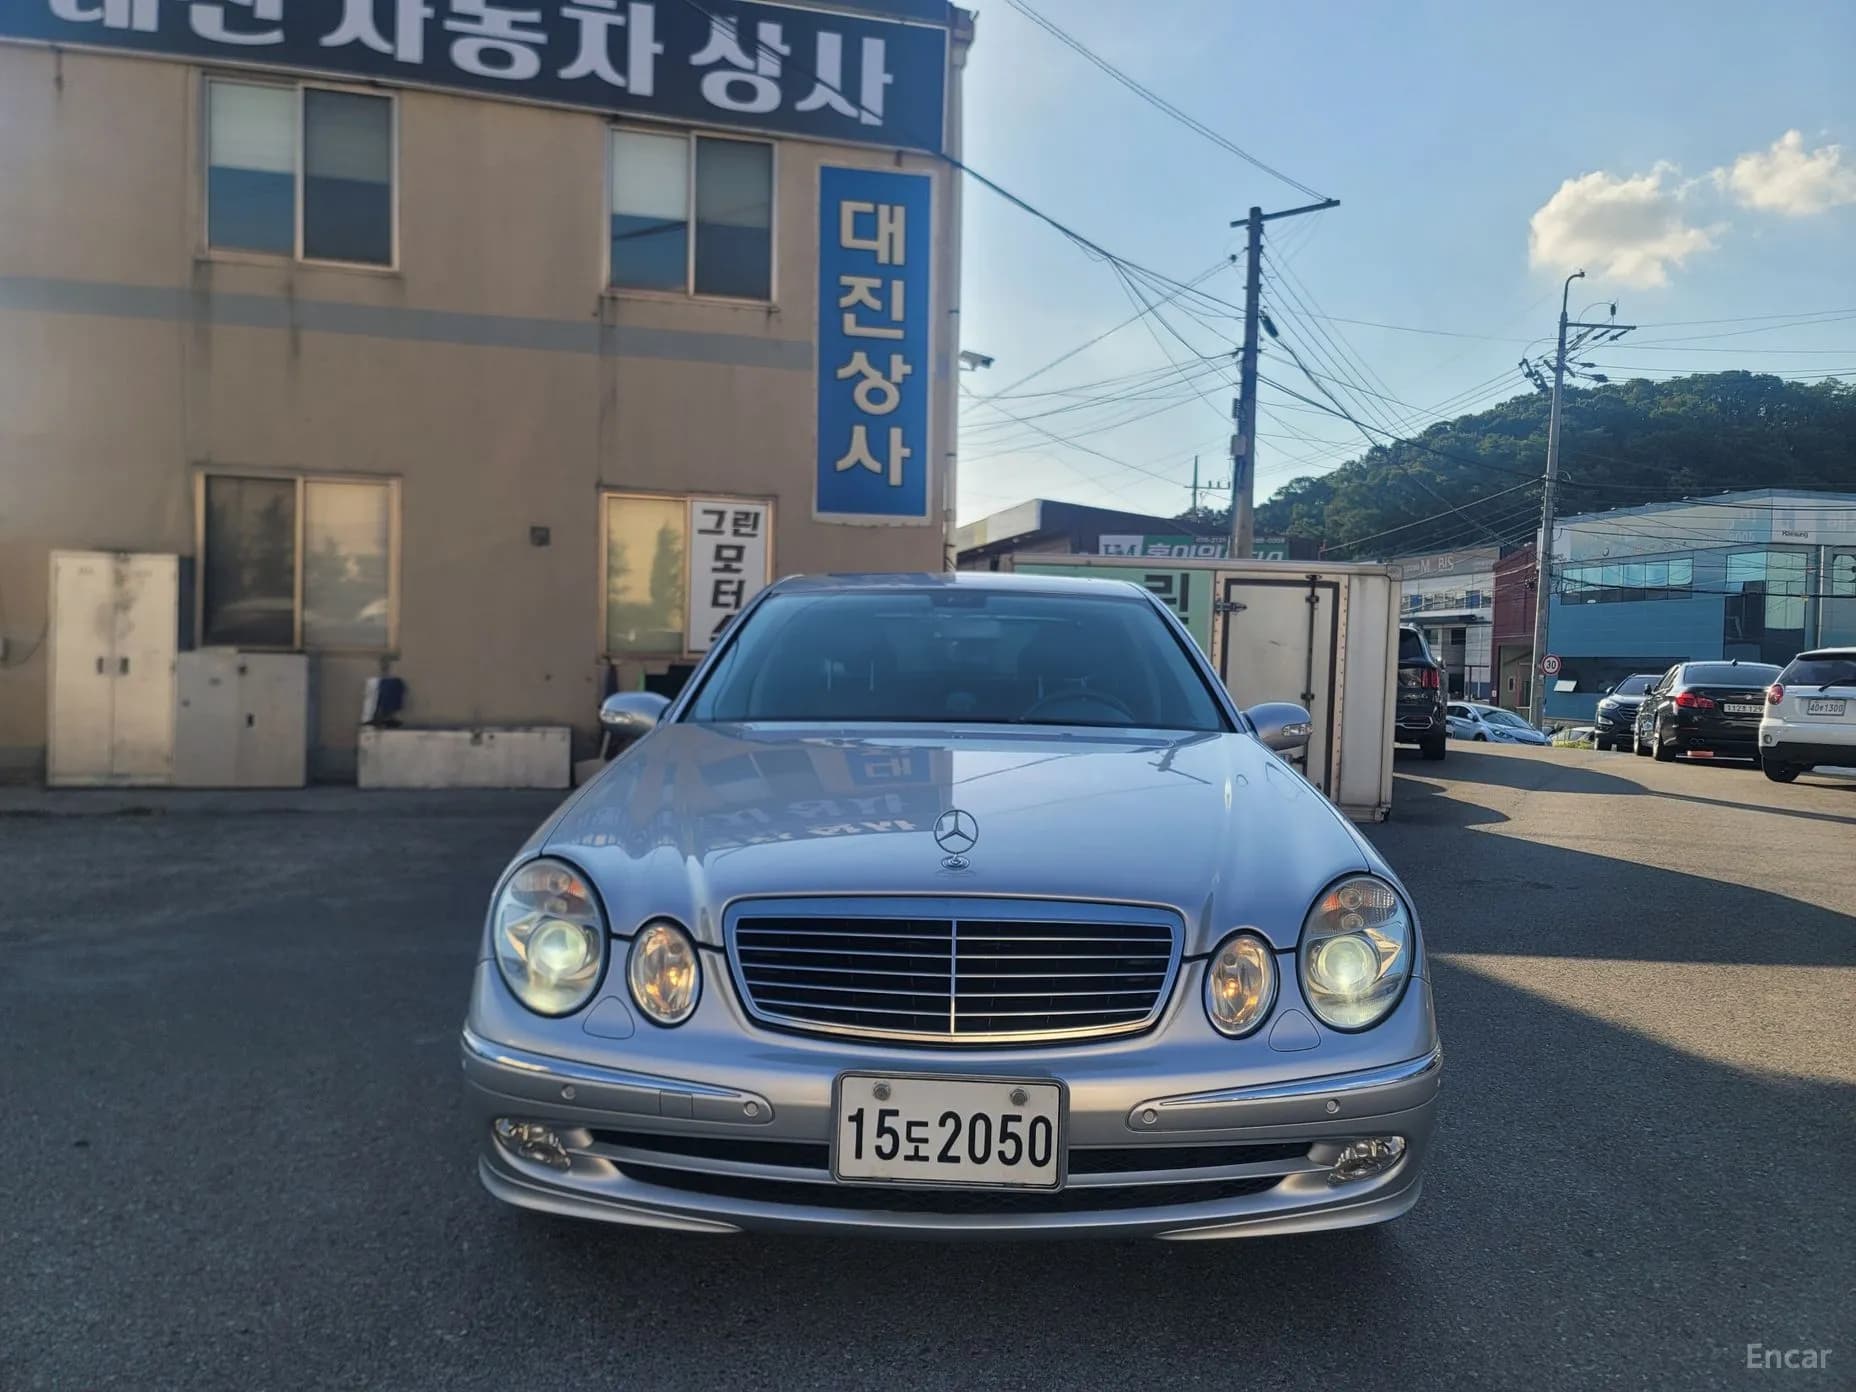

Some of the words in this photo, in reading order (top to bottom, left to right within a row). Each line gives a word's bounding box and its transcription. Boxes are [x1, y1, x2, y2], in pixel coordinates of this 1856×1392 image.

[319, 0, 664, 97] 자동차
[690, 14, 893, 126] 상사
[836, 200, 912, 487] 대진상사
[698, 509, 761, 538] 그린
[1546, 660, 1557, 670] 30
[848, 1107, 1053, 1168] 15도2050
